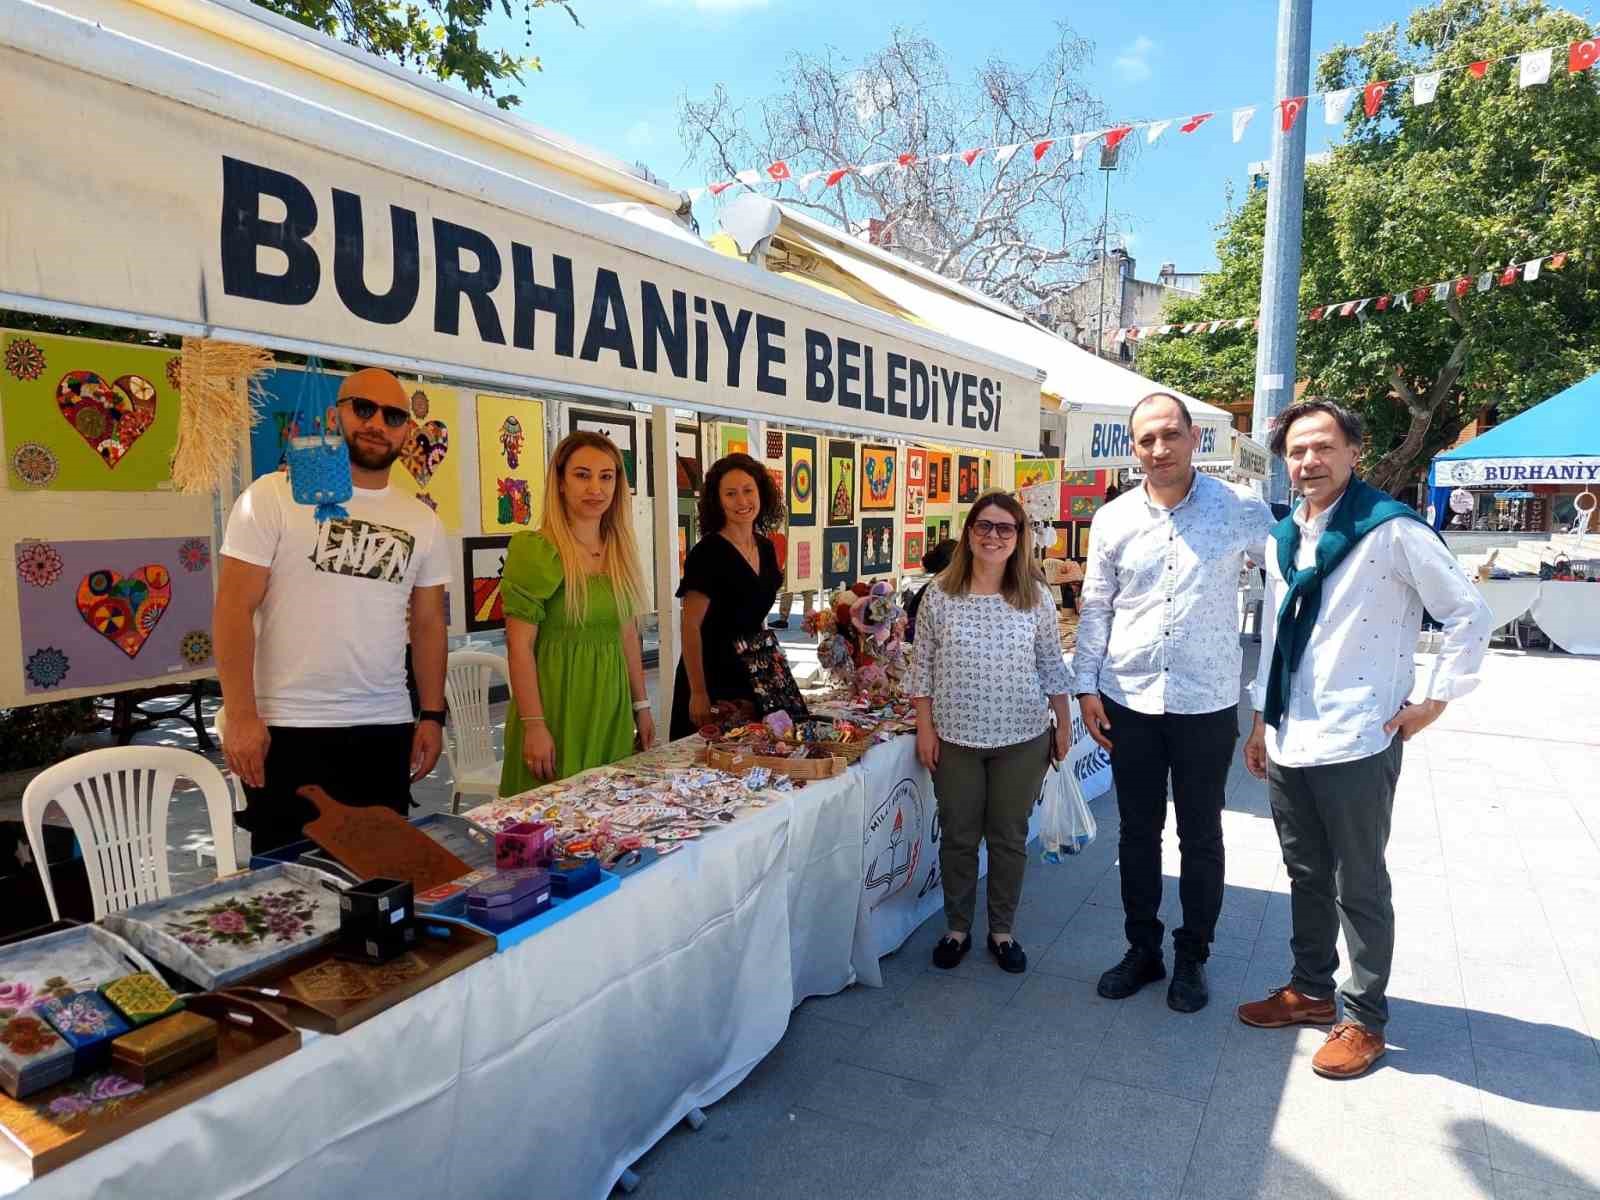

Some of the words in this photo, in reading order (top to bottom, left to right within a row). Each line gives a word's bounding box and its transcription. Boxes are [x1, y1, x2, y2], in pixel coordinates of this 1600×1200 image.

[221, 155, 786, 396] BURHANİYE
[805, 328, 1001, 432] BELEDİYESİ
[1091, 423, 1132, 458] BURH
